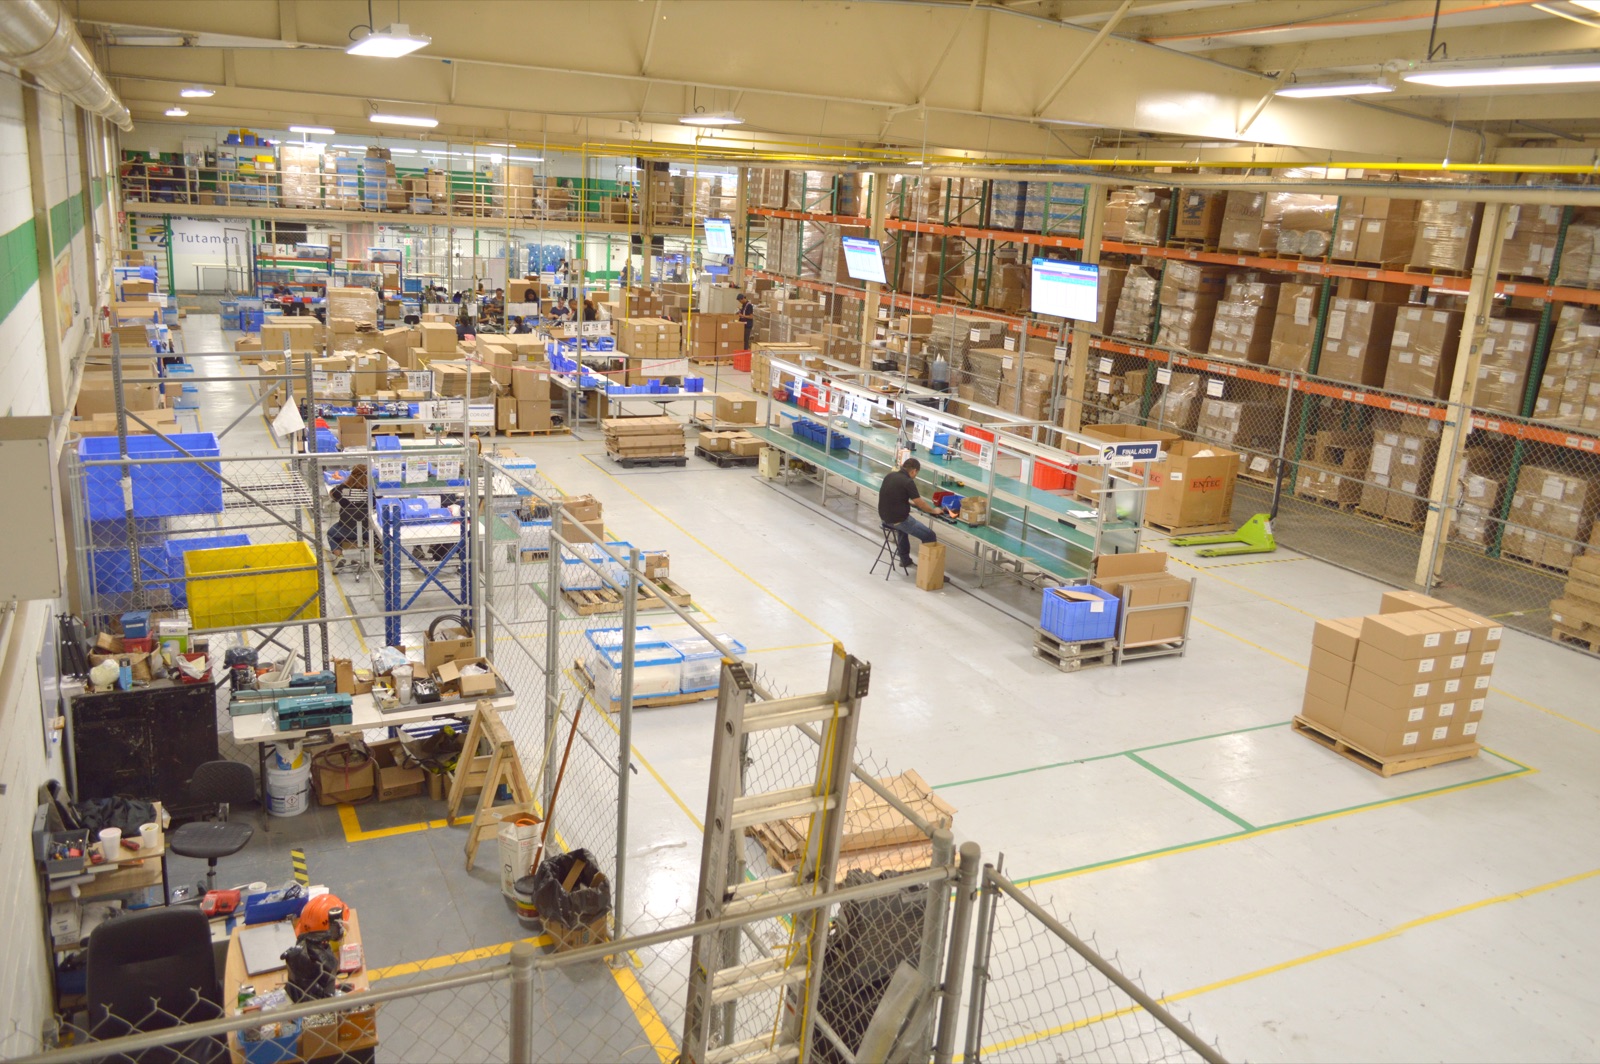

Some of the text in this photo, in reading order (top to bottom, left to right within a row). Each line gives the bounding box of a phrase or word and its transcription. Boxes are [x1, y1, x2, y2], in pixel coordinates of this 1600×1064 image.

[178, 232, 239, 244] Tutamen
[1134, 469, 1161, 483] ENEC
[1193, 479, 1220, 490] ENTEC
